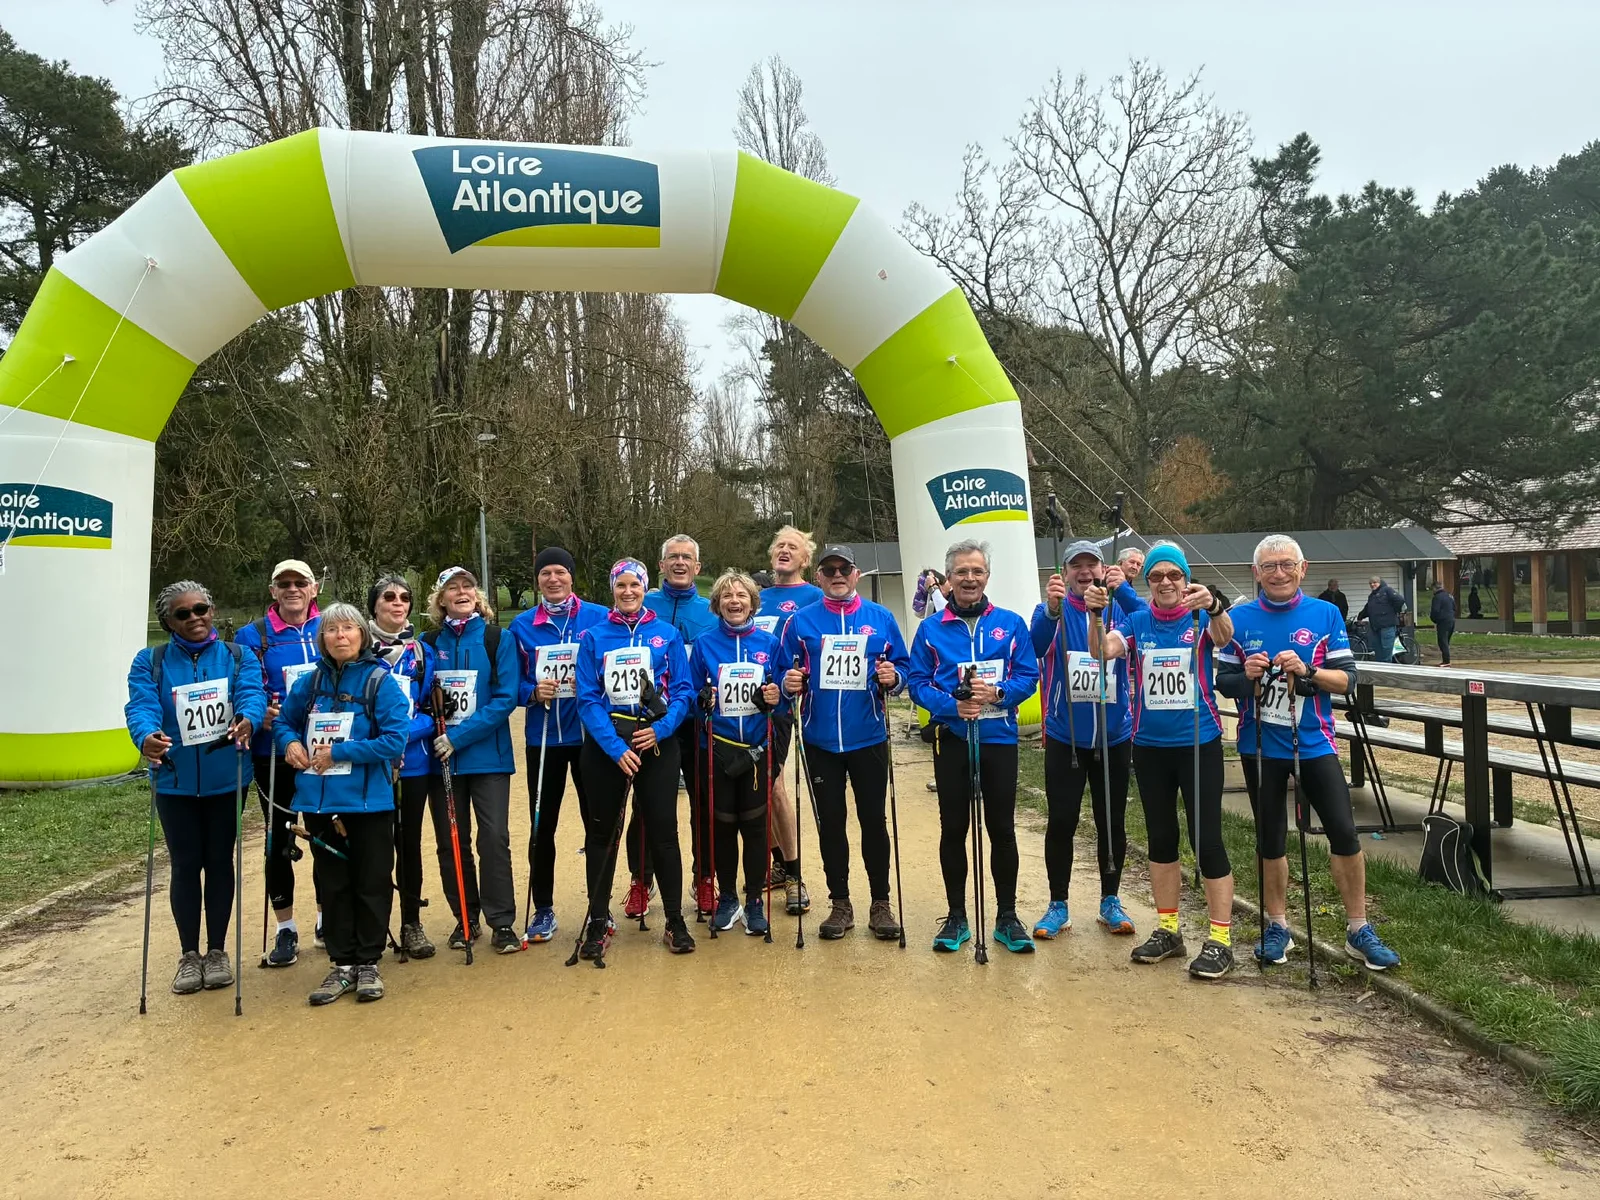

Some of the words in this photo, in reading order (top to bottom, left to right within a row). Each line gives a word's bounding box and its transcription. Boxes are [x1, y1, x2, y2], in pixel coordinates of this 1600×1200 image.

[452, 150, 543, 176] Loire
[452, 180, 643, 225] Atlantique
[942, 475, 986, 493] Loire
[0, 490, 40, 509] oire
[945, 491, 1024, 510] Atlantique
[0, 510, 103, 536] tlantique
[826, 655, 860, 677] 2113
[1148, 671, 1186, 695] 2106
[184, 702, 226, 731] 2102
